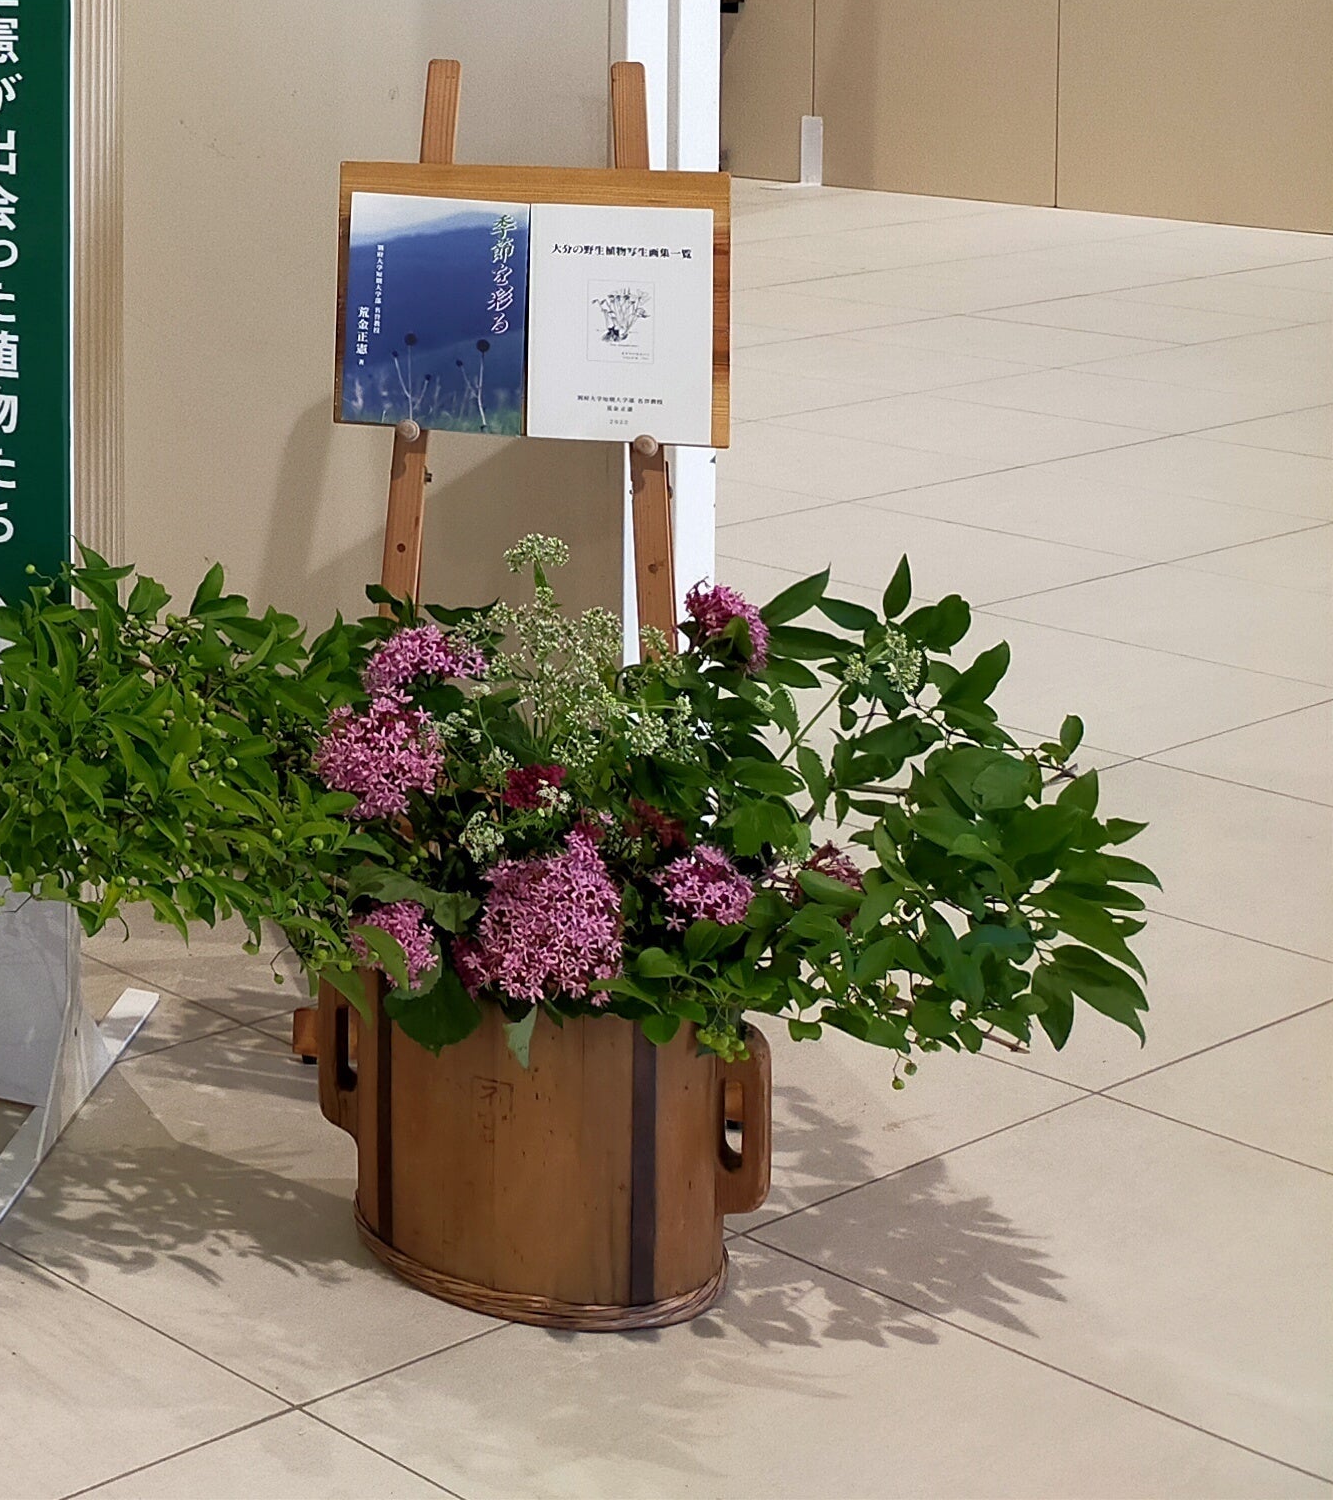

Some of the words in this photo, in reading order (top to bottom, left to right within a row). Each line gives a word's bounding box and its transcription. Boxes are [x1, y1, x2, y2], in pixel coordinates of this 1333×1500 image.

[551, 243, 692, 259] 大分の野生植物写生画集一覧
[356, 306, 370, 355] 荒金正憲
